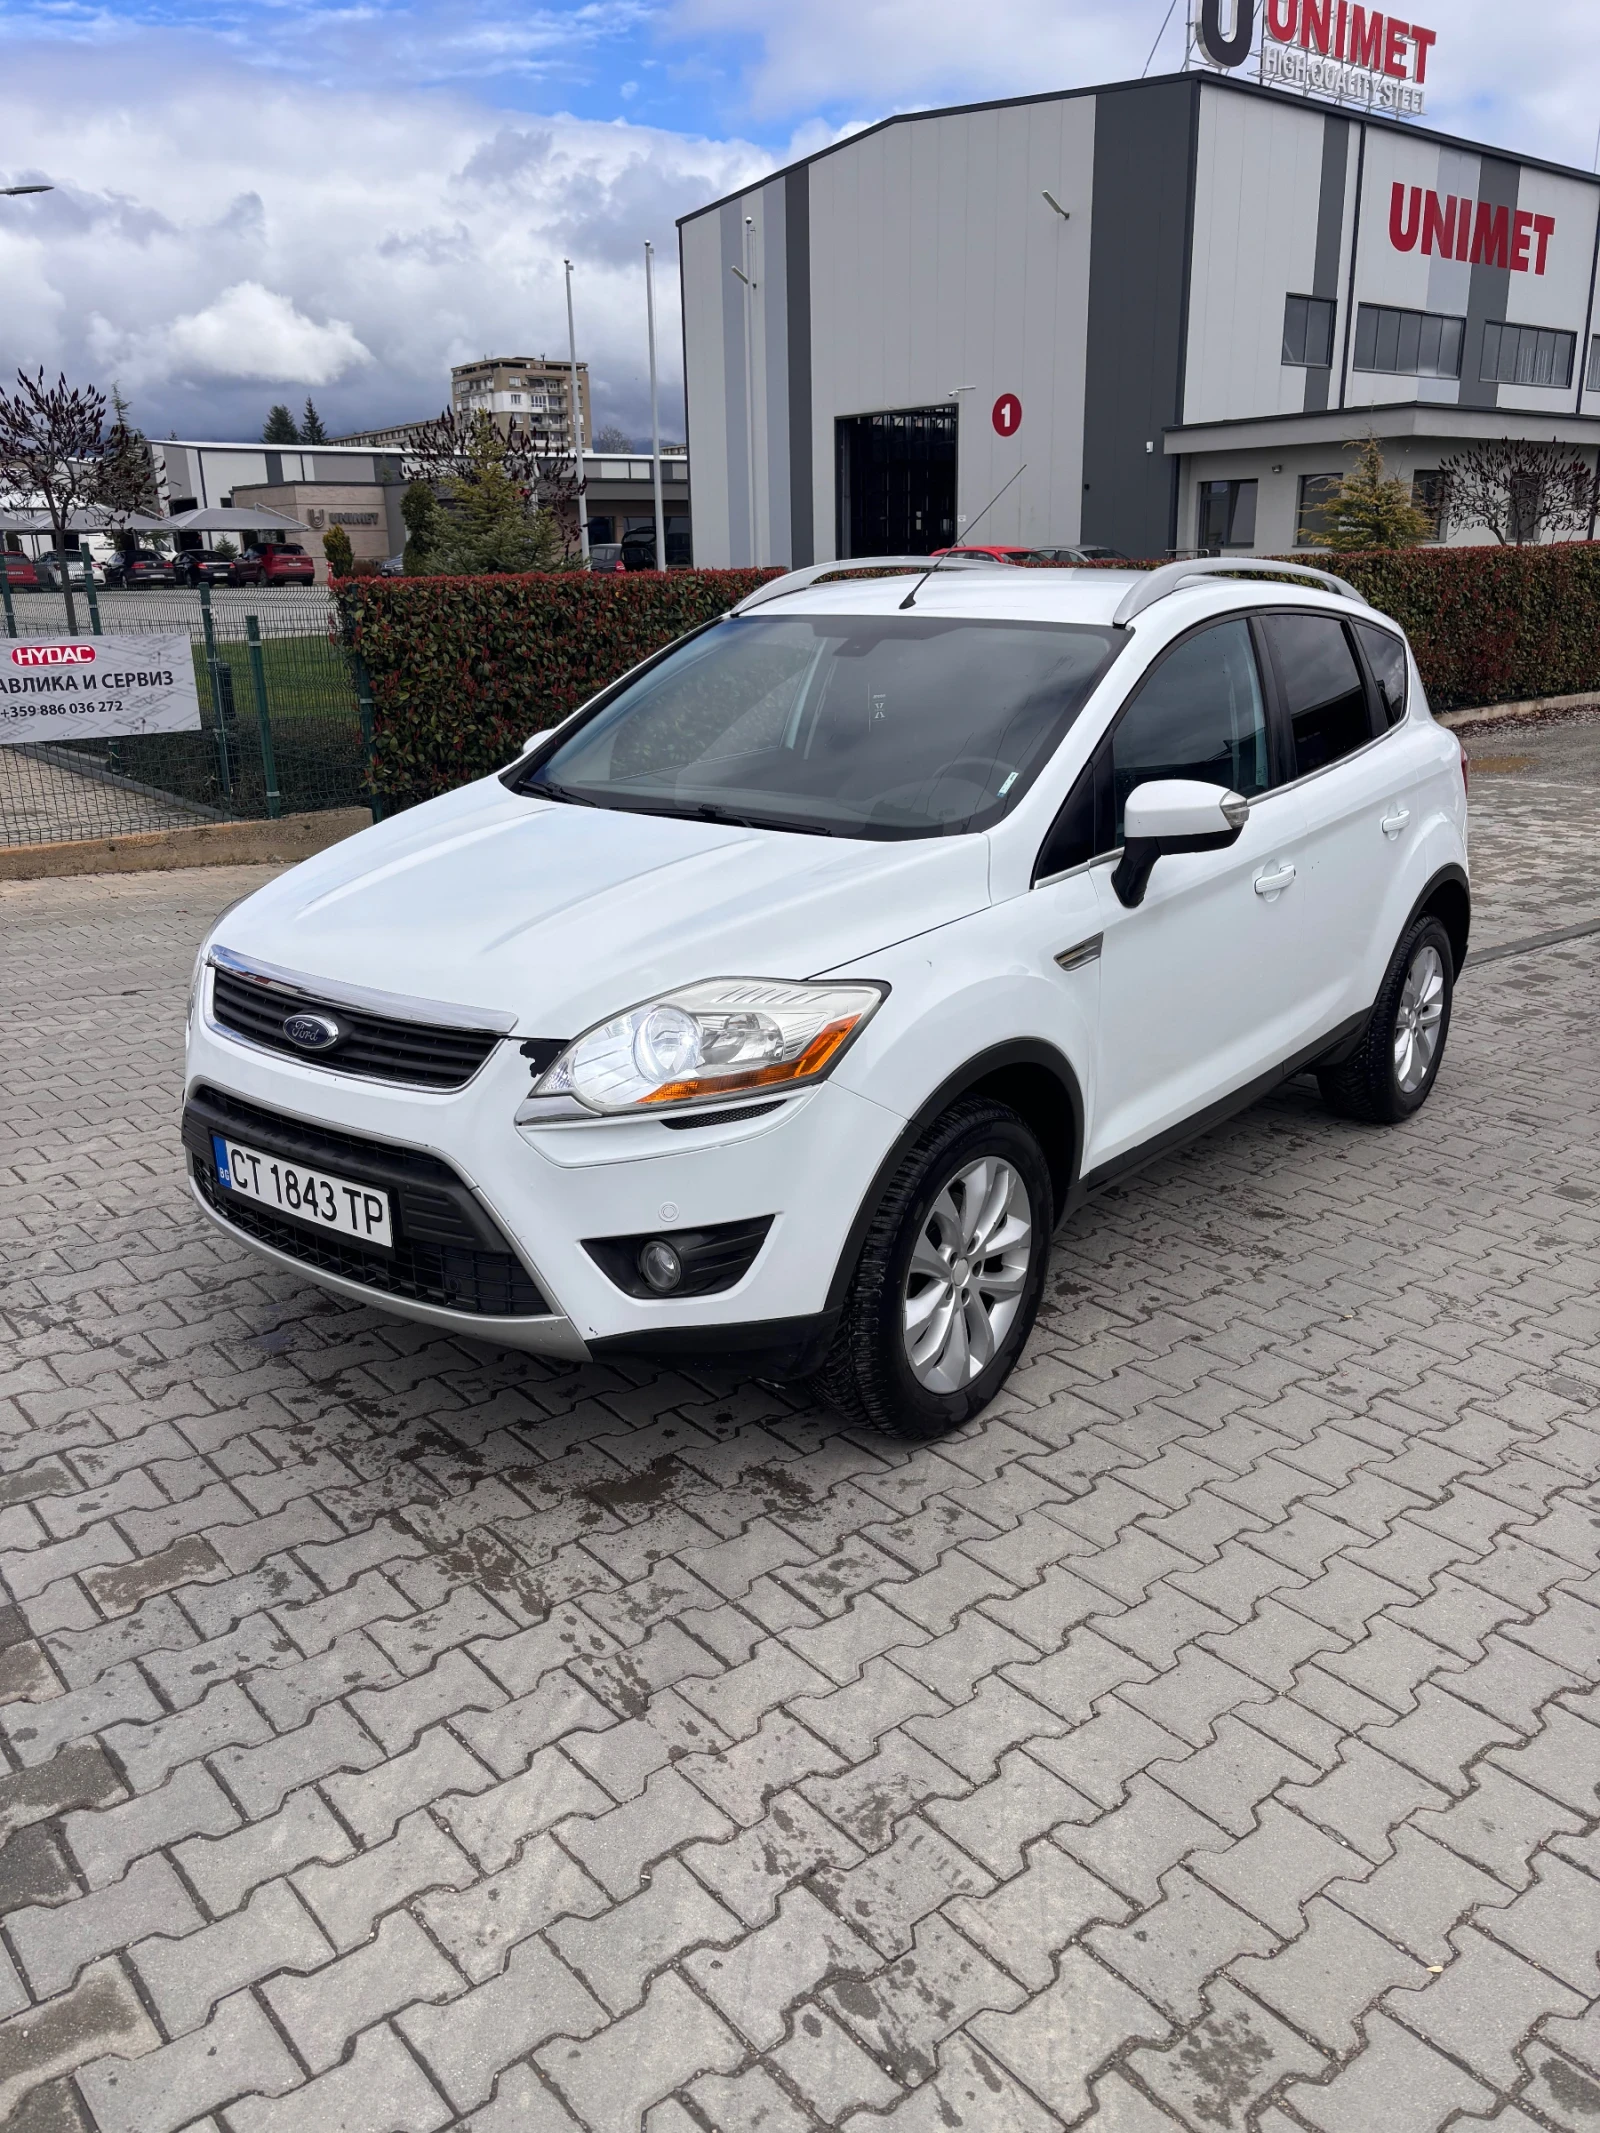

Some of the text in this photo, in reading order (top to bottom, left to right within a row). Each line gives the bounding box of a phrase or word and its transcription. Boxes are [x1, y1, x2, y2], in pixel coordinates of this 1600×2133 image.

[1264, 0, 1436, 84] UNIMET
[1264, 46, 1426, 114] HIGH QUALITY STEEL
[1389, 182, 1555, 276] UNIMET
[1001, 403, 1011, 428] 1
[16, 647, 92, 664] HYDAC
[83, 674, 97, 690] И
[101, 670, 174, 689] СЕРВИЗ
[0, 700, 123, 718] +359 886 036 272
[292, 1020, 320, 1041] Ford
[219, 1167, 231, 1181] BG
[230, 1148, 383, 1235] CT 1843 TP
